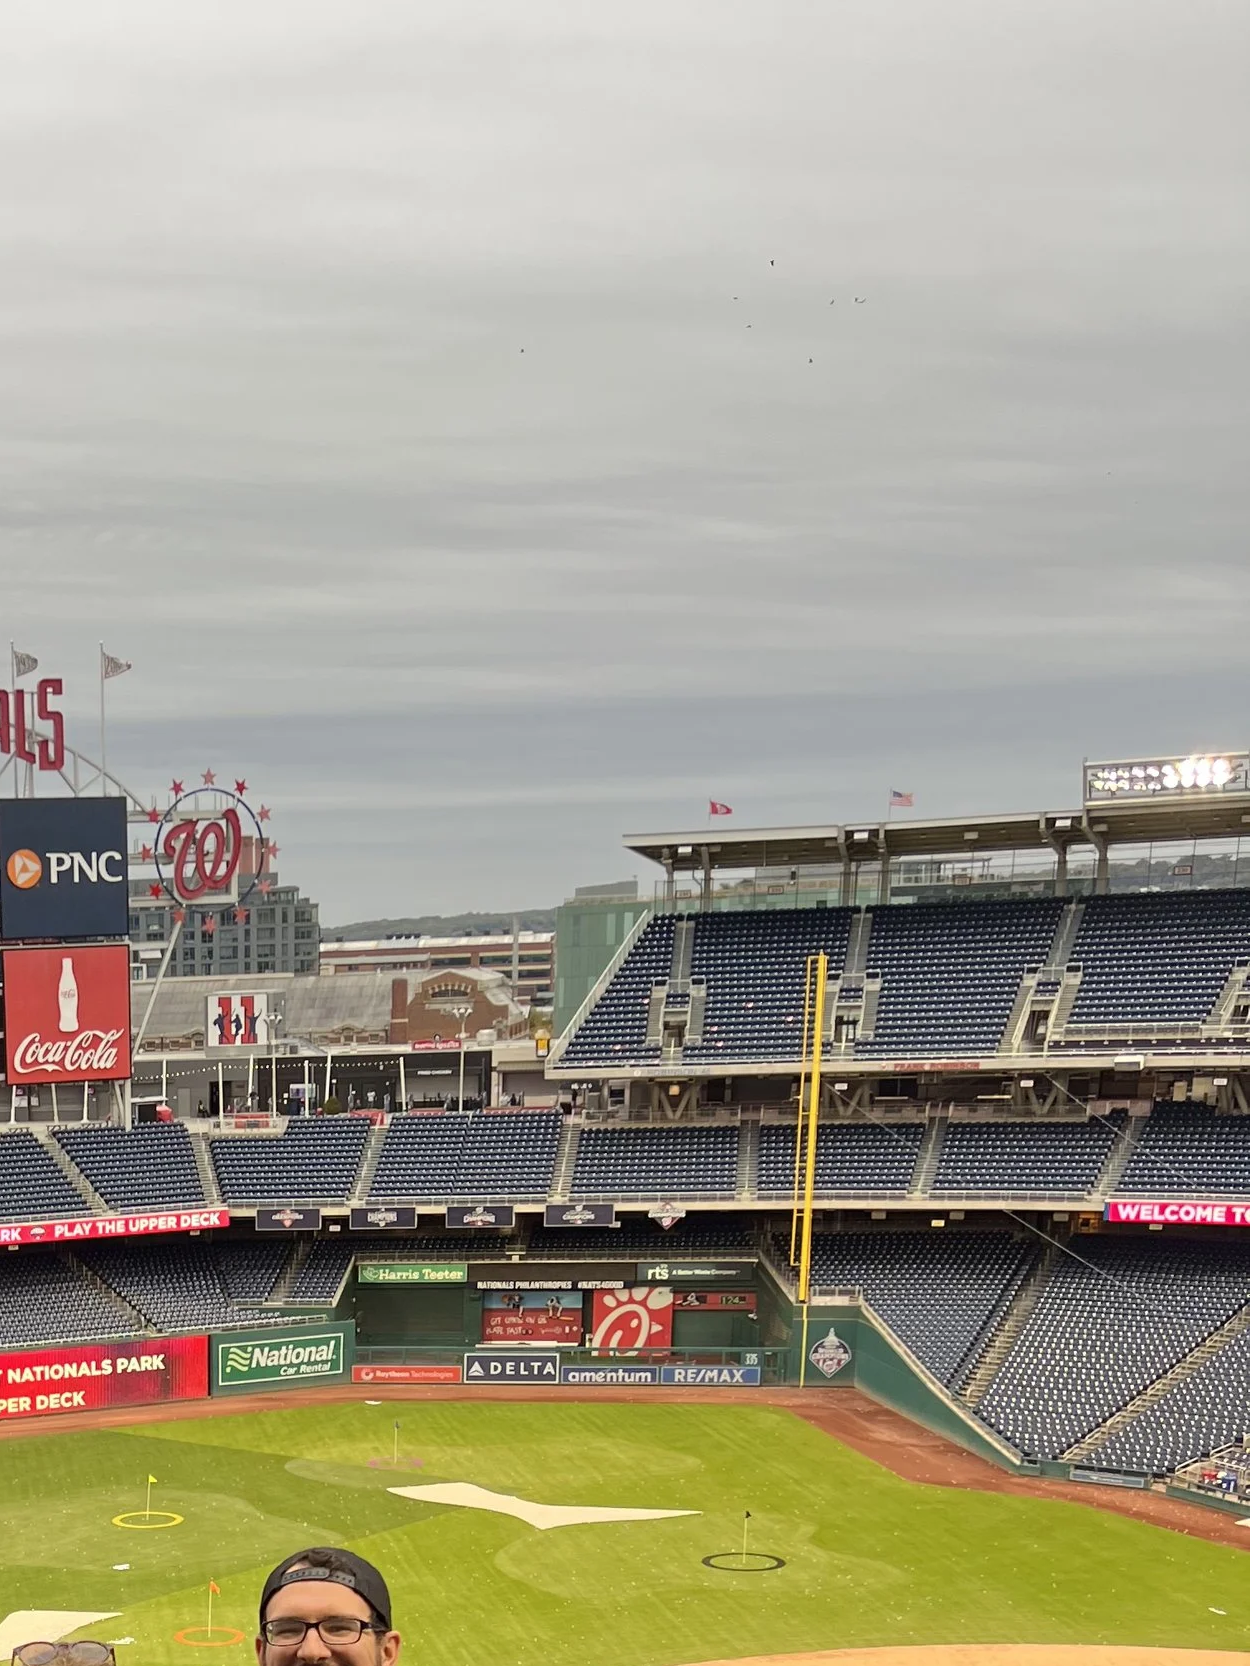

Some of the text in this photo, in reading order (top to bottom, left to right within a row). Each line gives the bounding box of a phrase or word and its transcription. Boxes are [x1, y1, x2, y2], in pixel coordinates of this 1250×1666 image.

[46, 851, 123, 884] PNC
[13, 1028, 125, 1074] Coca-Cola
[1117, 1204, 1227, 1222] WELCOME
[54, 1222, 95, 1238] PLAY
[96, 1219, 126, 1235] THE
[128, 1215, 179, 1232] UPPER
[180, 1211, 221, 1228] DECK
[379, 1267, 463, 1281] Harris Teeter
[477, 1281, 514, 1289] NATIONALS
[515, 1281, 572, 1289] PHILANTHROPIES
[7, 1359, 112, 1385] NATIONALS
[117, 1353, 165, 1375] PARK
[280, 1362, 331, 1375] Car Rental
[375, 1369, 453, 1379] Raytheon Technologies
[490, 1361, 556, 1375] DELTA
[568, 1368, 651, 1383] amentum
[674, 1367, 745, 1383] RE/MAX
[35, 1391, 85, 1410] DECK
